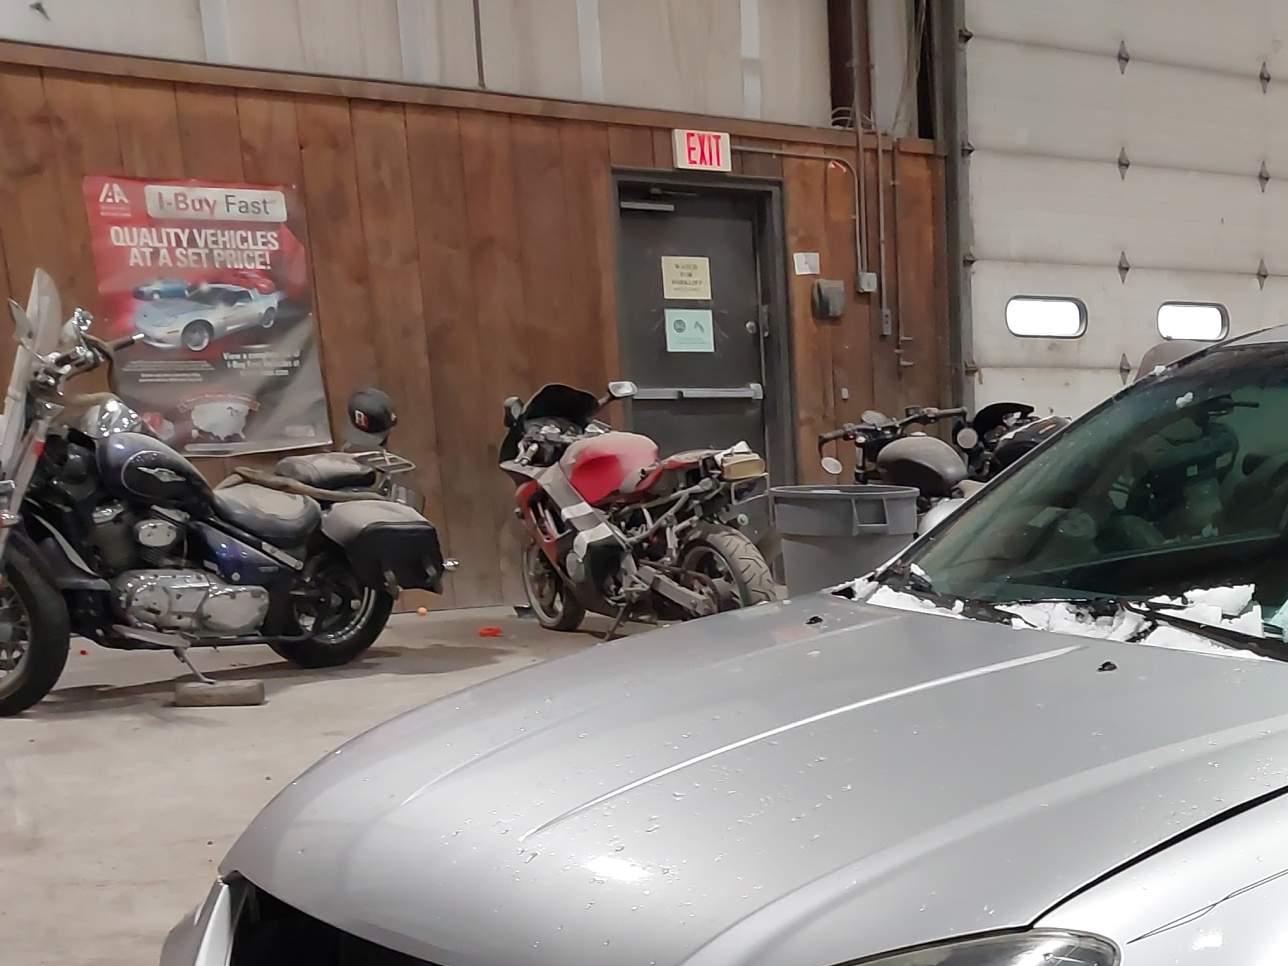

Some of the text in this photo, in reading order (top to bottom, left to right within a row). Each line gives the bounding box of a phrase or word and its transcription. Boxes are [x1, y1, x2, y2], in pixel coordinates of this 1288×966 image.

[686, 132, 722, 167] EXIT
[157, 191, 217, 217] I-Buy
[224, 194, 270, 215] Fast
[110, 226, 280, 251] QUALITY VEHICLES
[129, 247, 272, 270] AT A SET PRICE!
